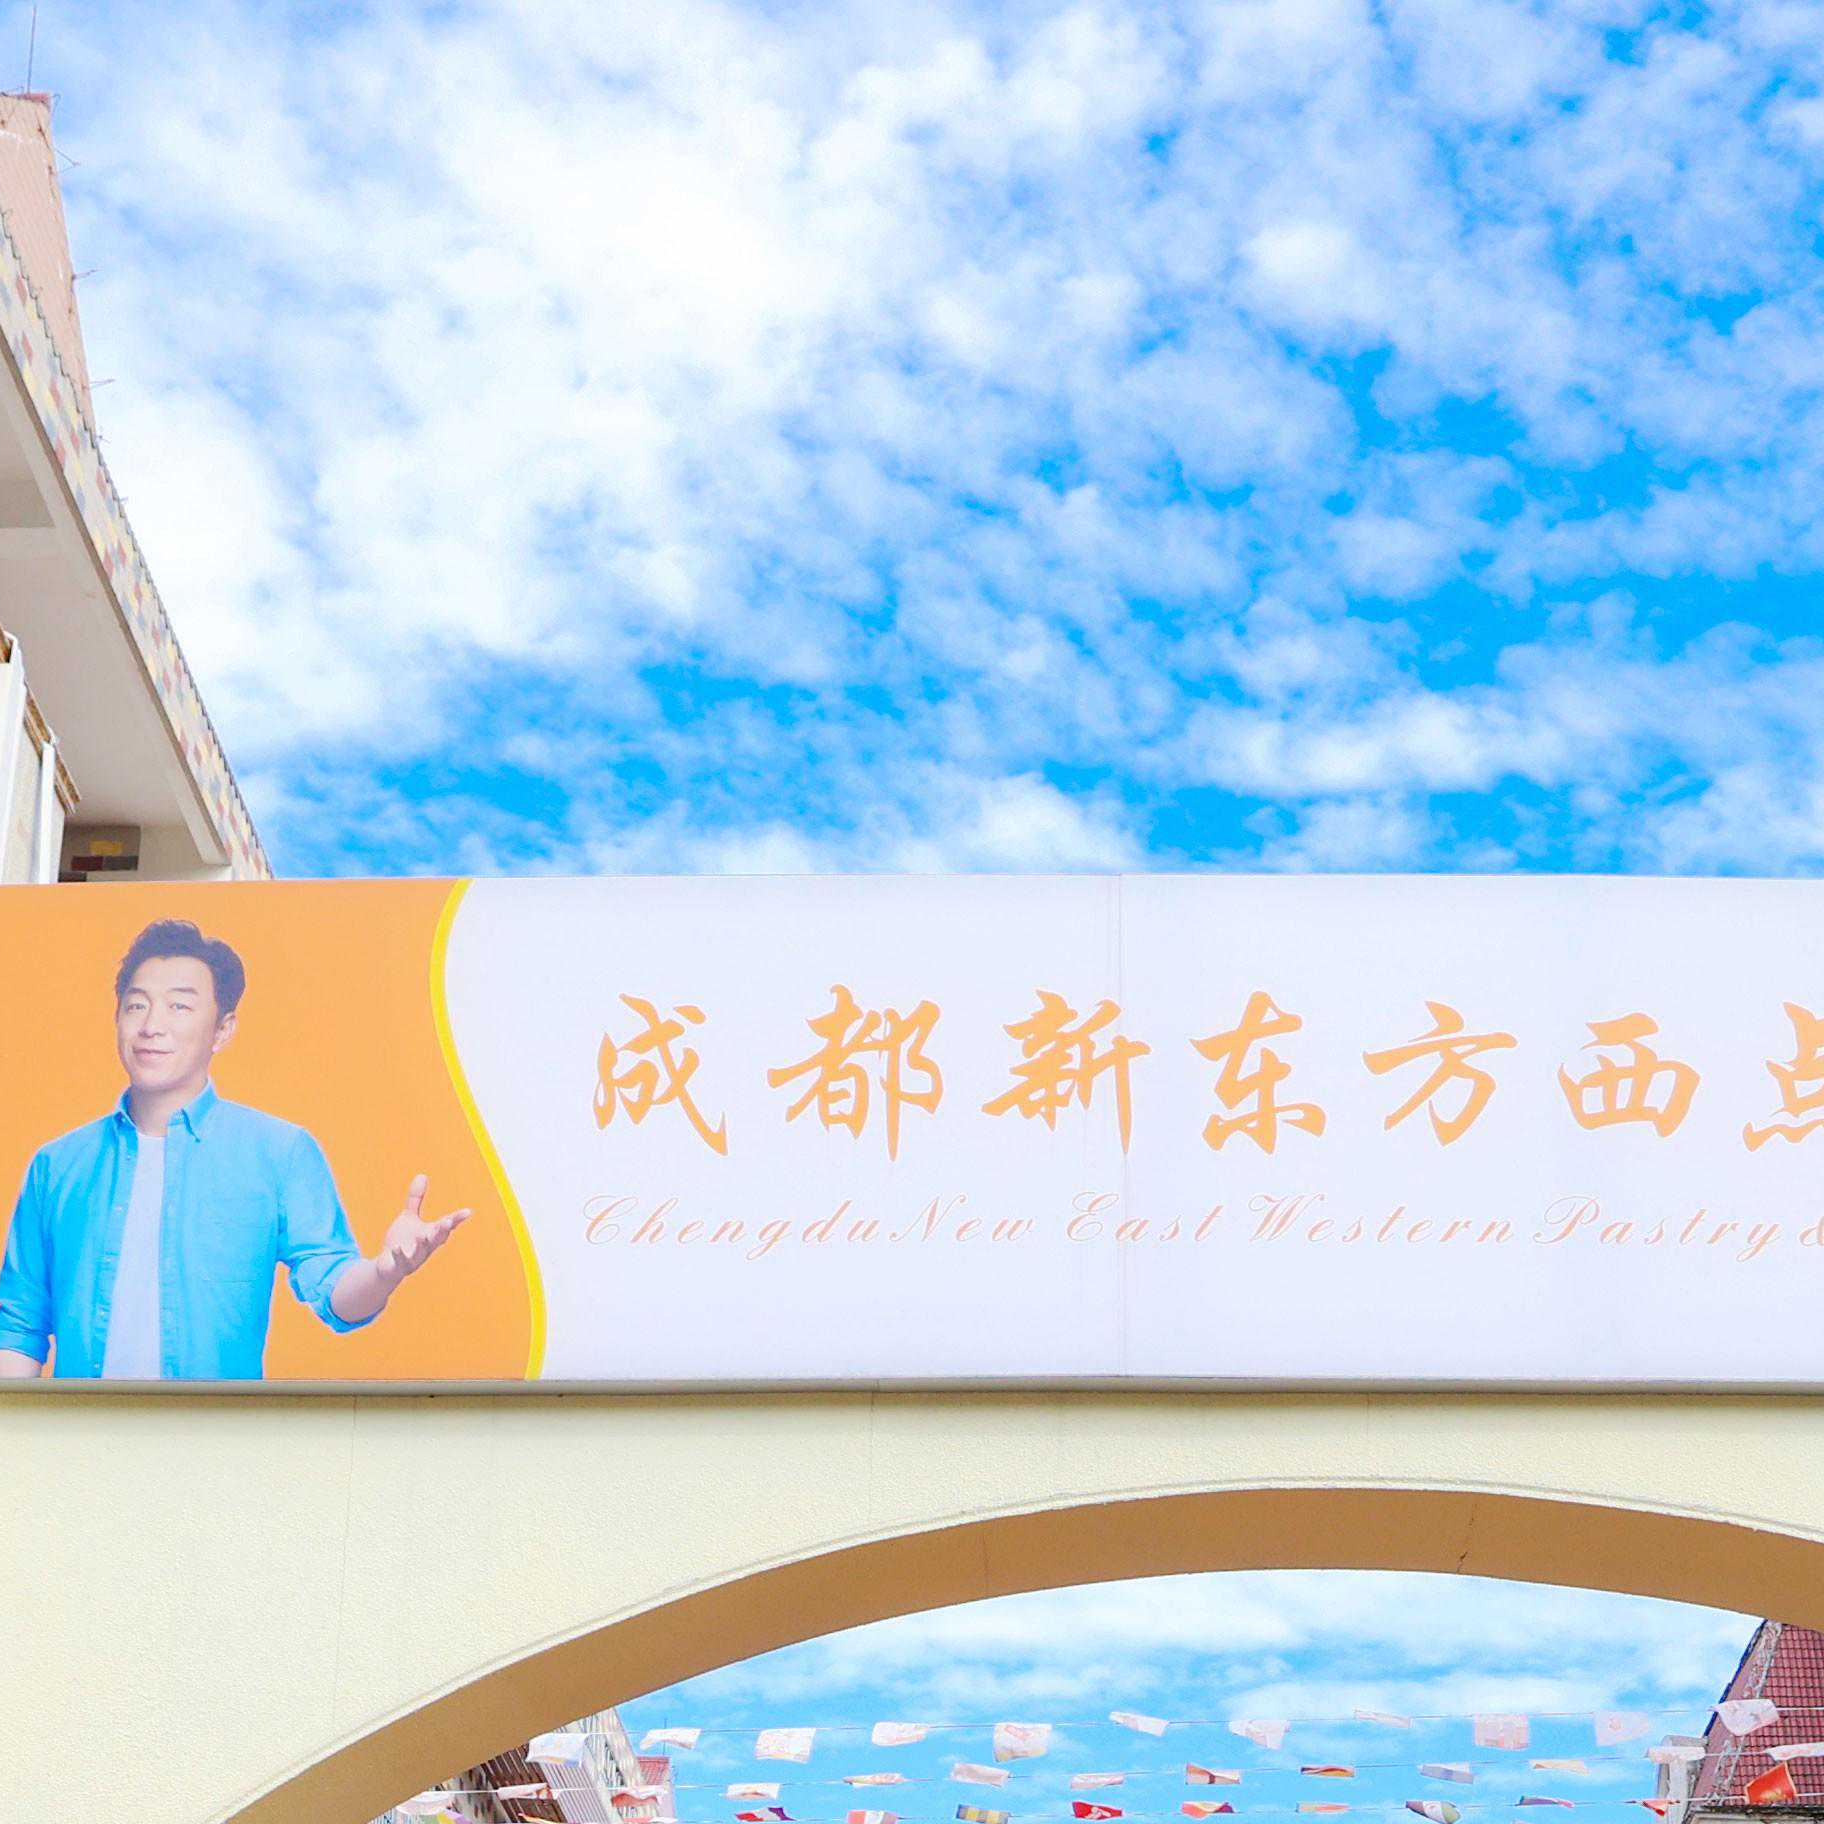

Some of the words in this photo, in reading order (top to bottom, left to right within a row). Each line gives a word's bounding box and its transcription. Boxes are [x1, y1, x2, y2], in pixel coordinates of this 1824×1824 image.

[1066, 1191, 1228, 1244] East
[1248, 1193, 1515, 1245] Western
[1532, 1195, 1782, 1263] Pastry
